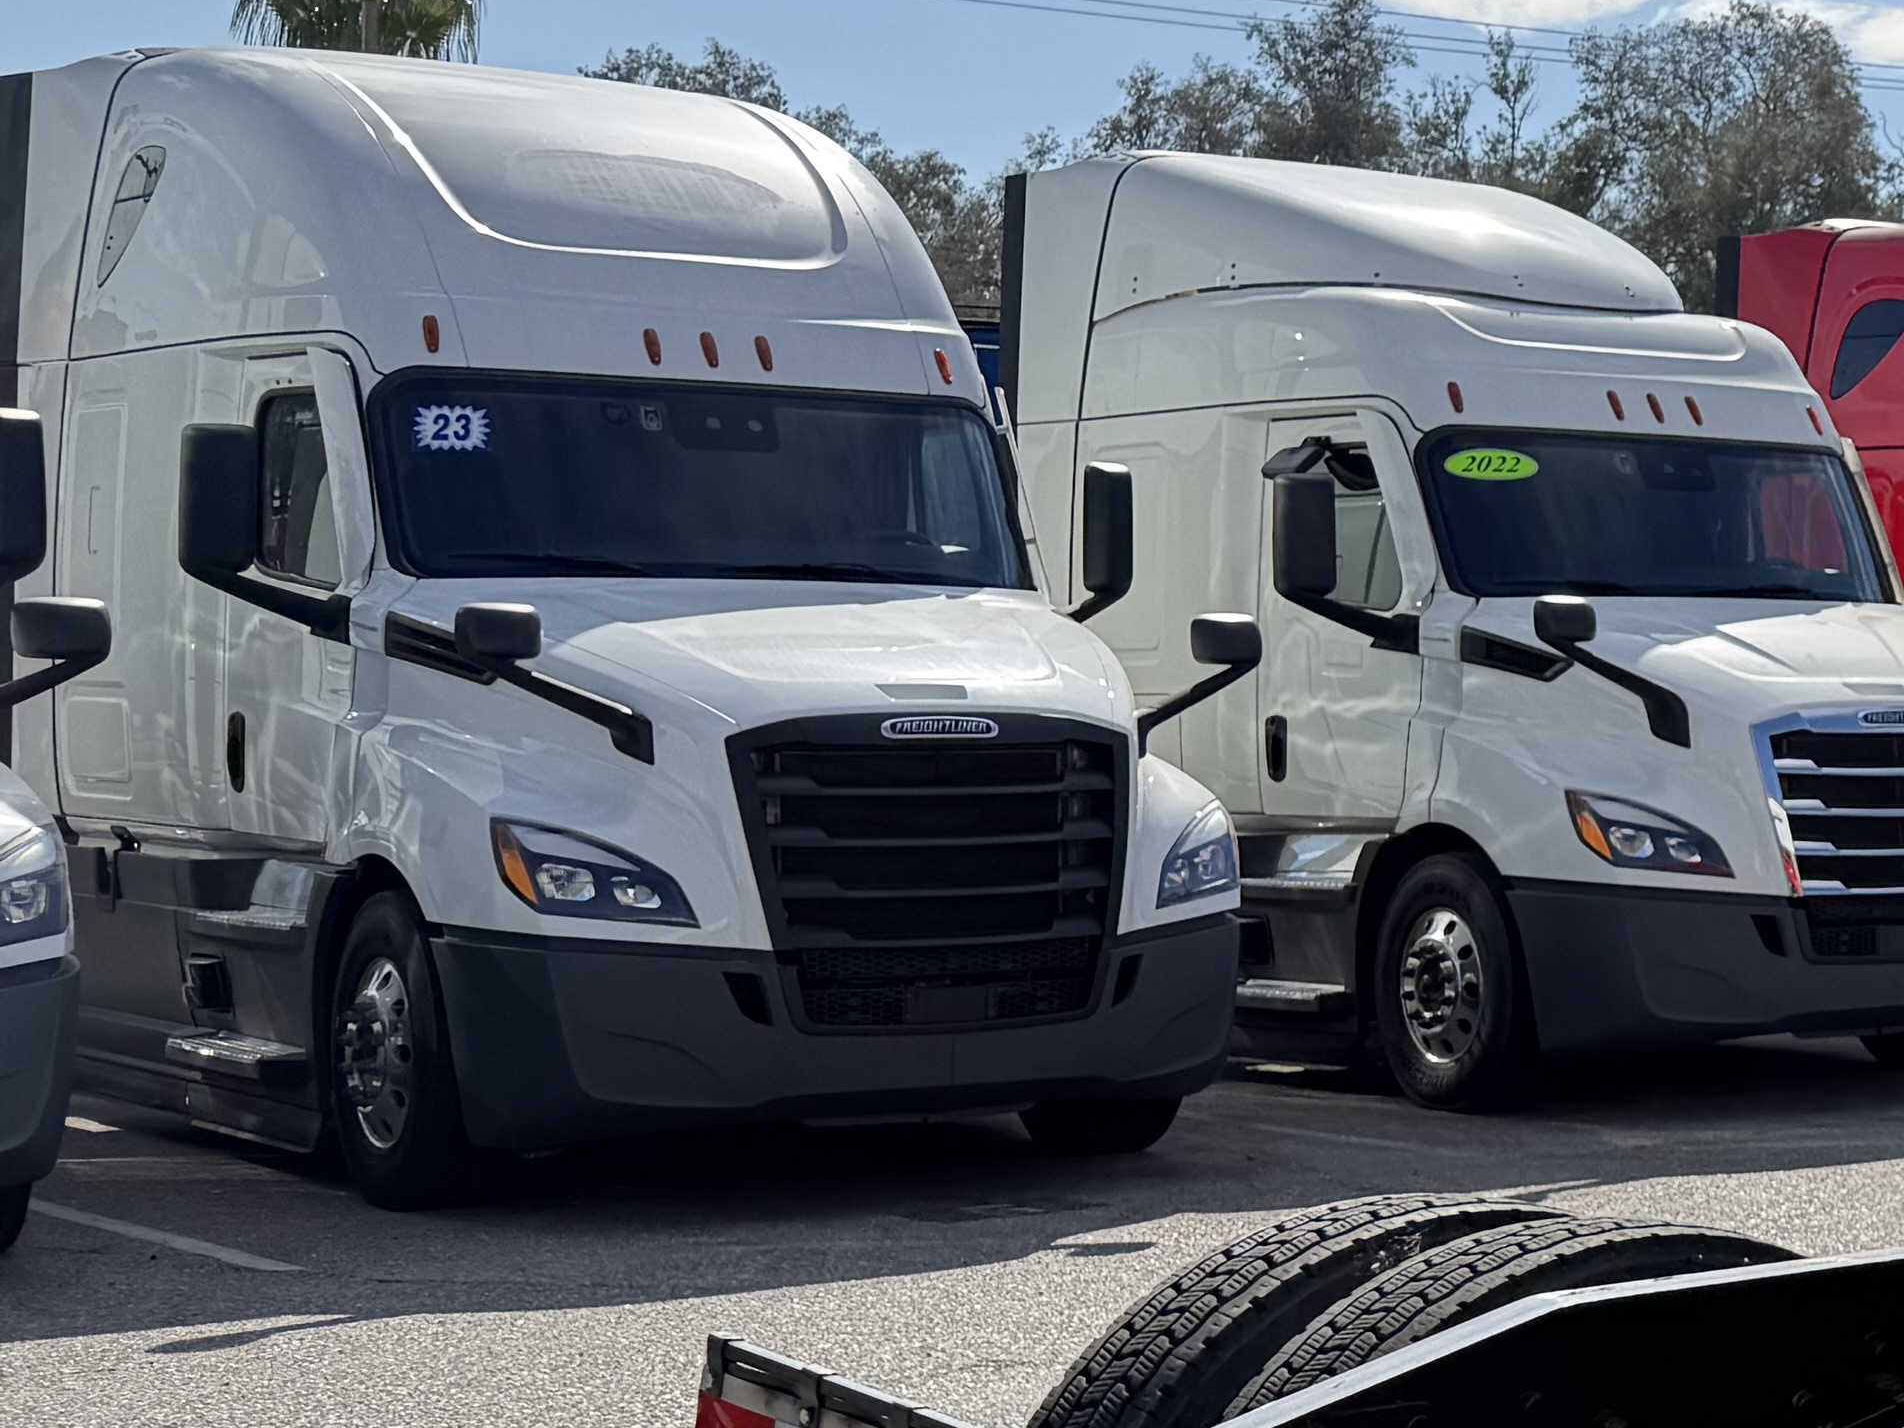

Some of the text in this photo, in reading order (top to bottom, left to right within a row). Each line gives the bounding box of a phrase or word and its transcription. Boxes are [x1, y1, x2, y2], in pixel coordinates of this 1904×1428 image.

[431, 413, 471, 441] 23
[1461, 455, 1521, 473] 2022
[895, 719, 987, 733] FREIGHTLINER
